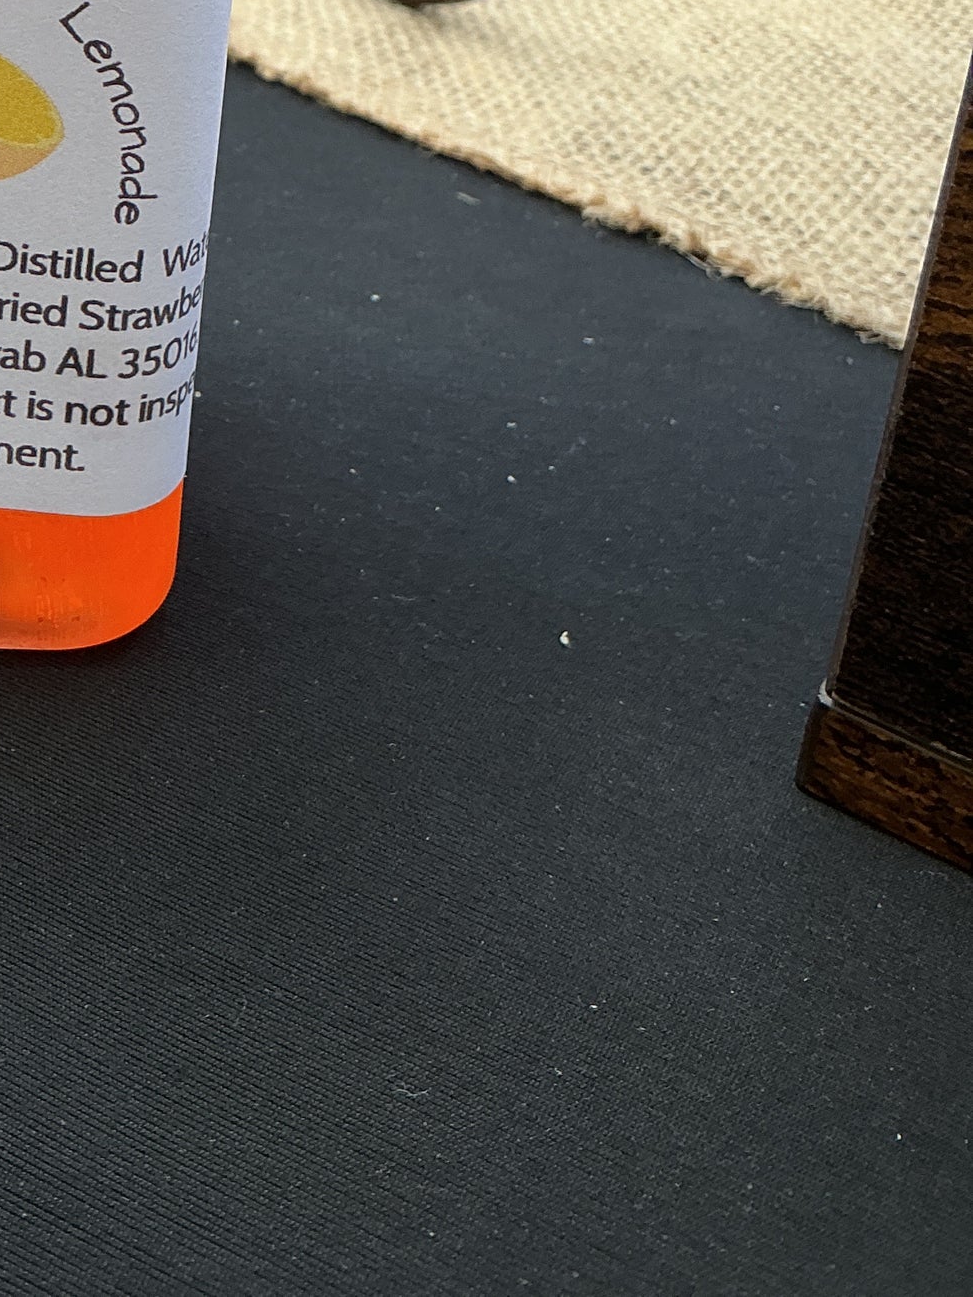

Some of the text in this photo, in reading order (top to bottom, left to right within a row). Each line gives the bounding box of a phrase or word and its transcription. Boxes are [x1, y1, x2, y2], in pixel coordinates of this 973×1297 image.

[59, 2, 158, 226] Lemonade
[163, 231, 207, 278] Wat
[79, 279, 204, 332] Strawbe
[55, 347, 108, 379] AL
[27, 390, 53, 420] is
[64, 400, 131, 427] not
